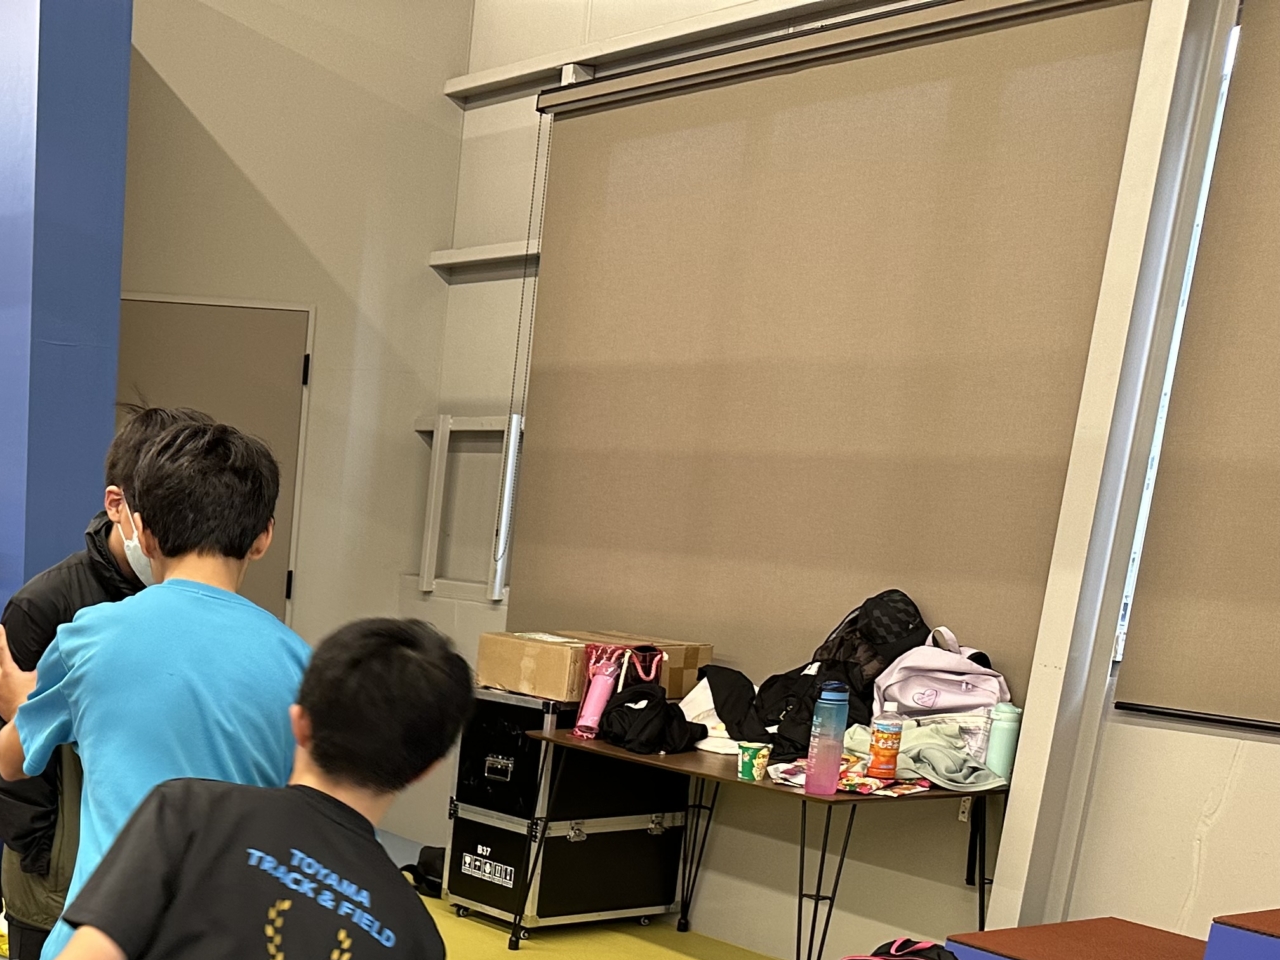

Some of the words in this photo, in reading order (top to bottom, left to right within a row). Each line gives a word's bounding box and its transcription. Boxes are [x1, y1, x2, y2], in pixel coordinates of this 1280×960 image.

[290, 848, 372, 908] TOYAMA
[477, 844, 491, 856] B37
[246, 847, 318, 899] TRACK
[316, 889, 336, 910] &
[337, 900, 397, 948] FIELD
